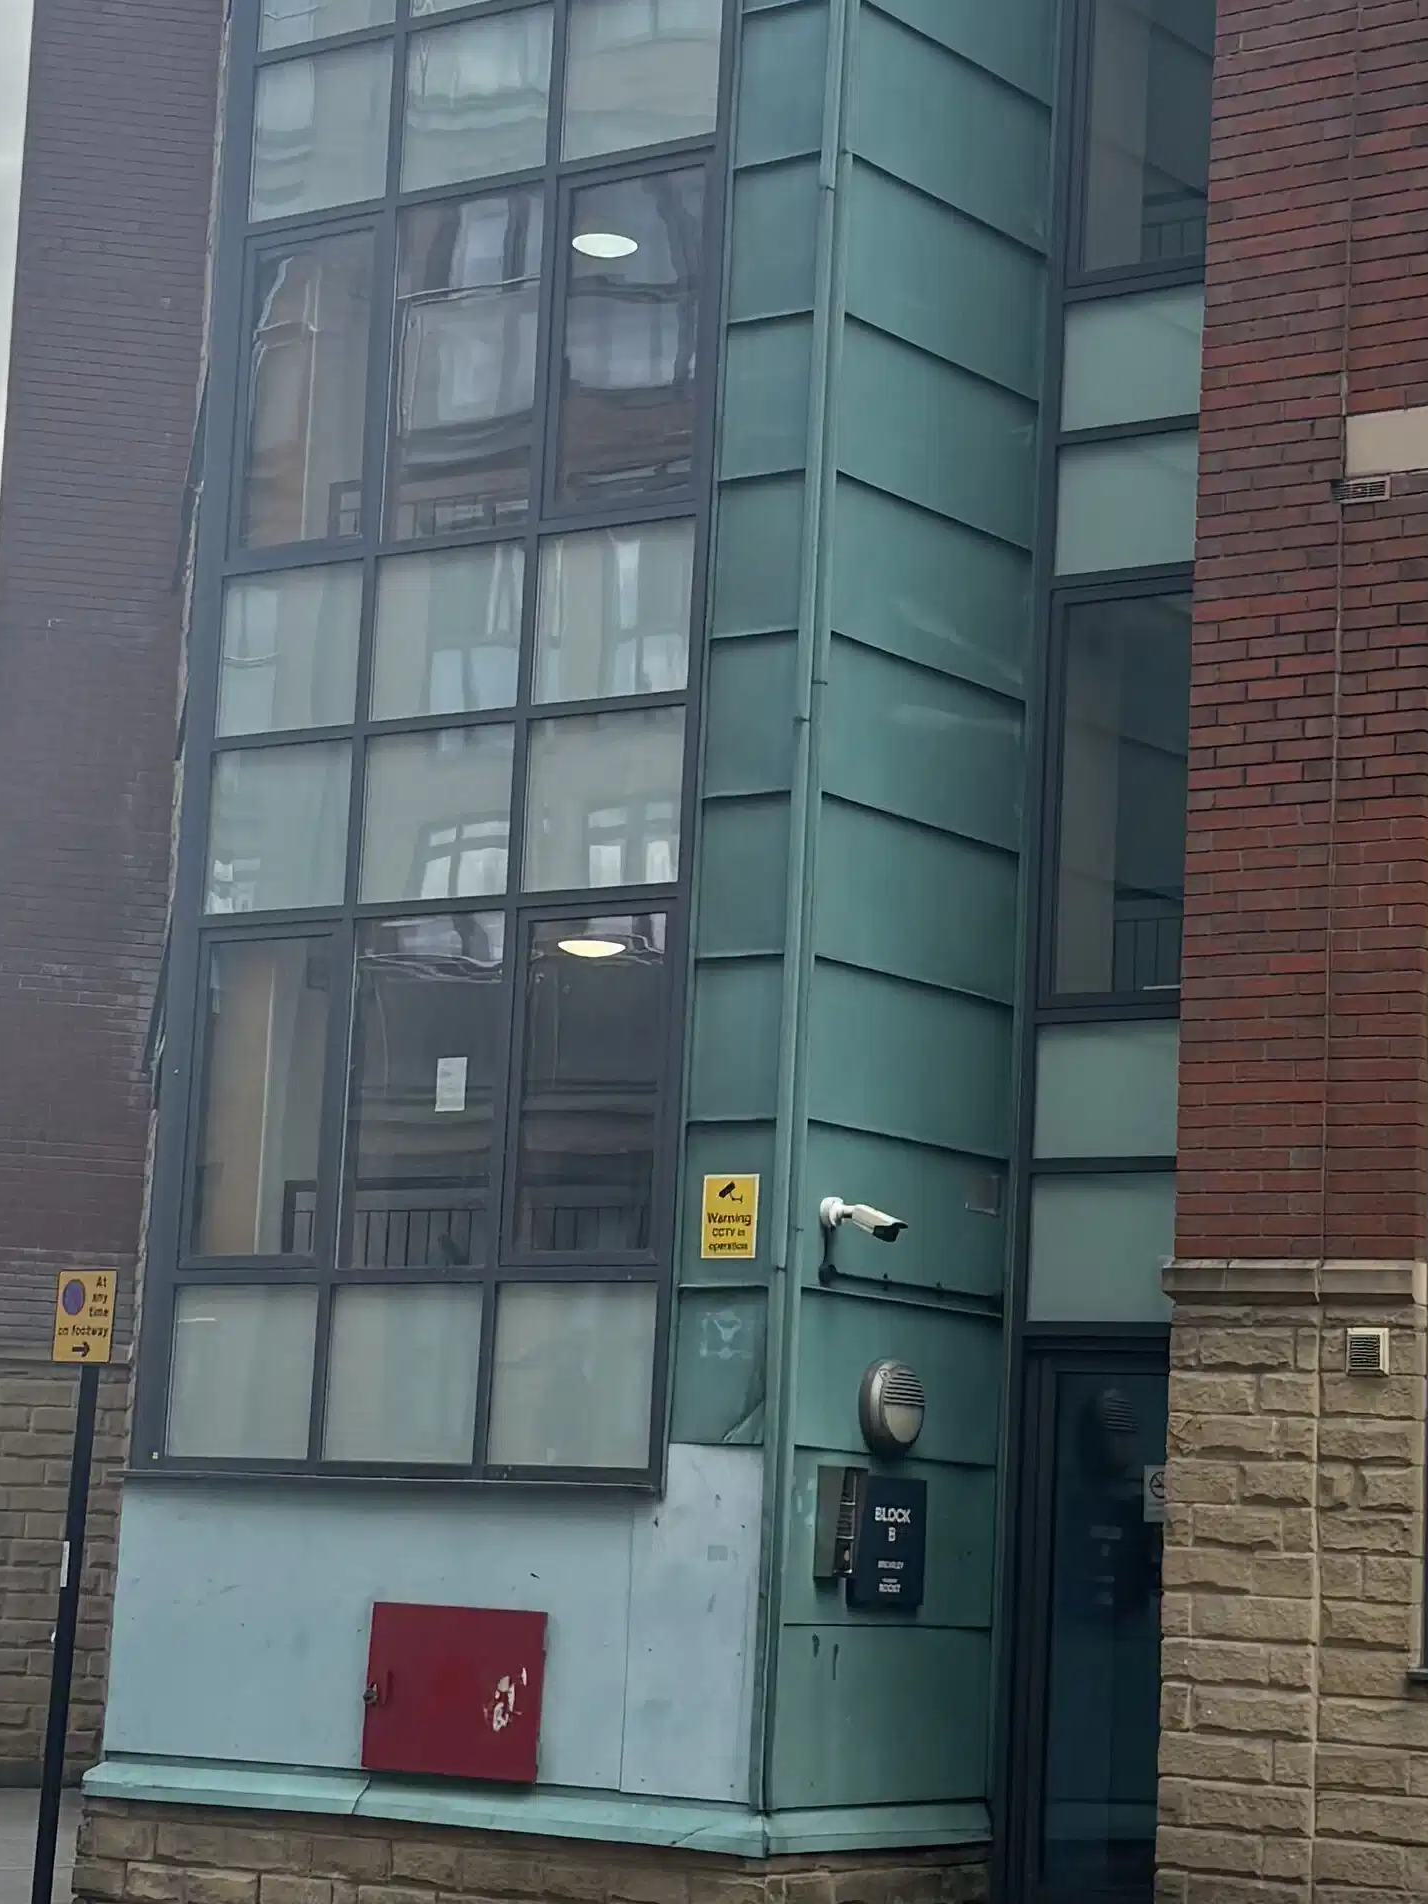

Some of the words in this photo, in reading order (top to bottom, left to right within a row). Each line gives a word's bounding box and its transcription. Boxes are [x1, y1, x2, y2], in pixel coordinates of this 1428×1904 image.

[707, 1212, 752, 1226] Warning
[712, 1227, 735, 1237] CCTV
[737, 1228, 746, 1236] in
[96, 1275, 107, 1288] At
[92, 1293, 108, 1304] any
[89, 1306, 109, 1317] time
[875, 1506, 911, 1524] BLOCK
[888, 1527, 896, 1542] B
